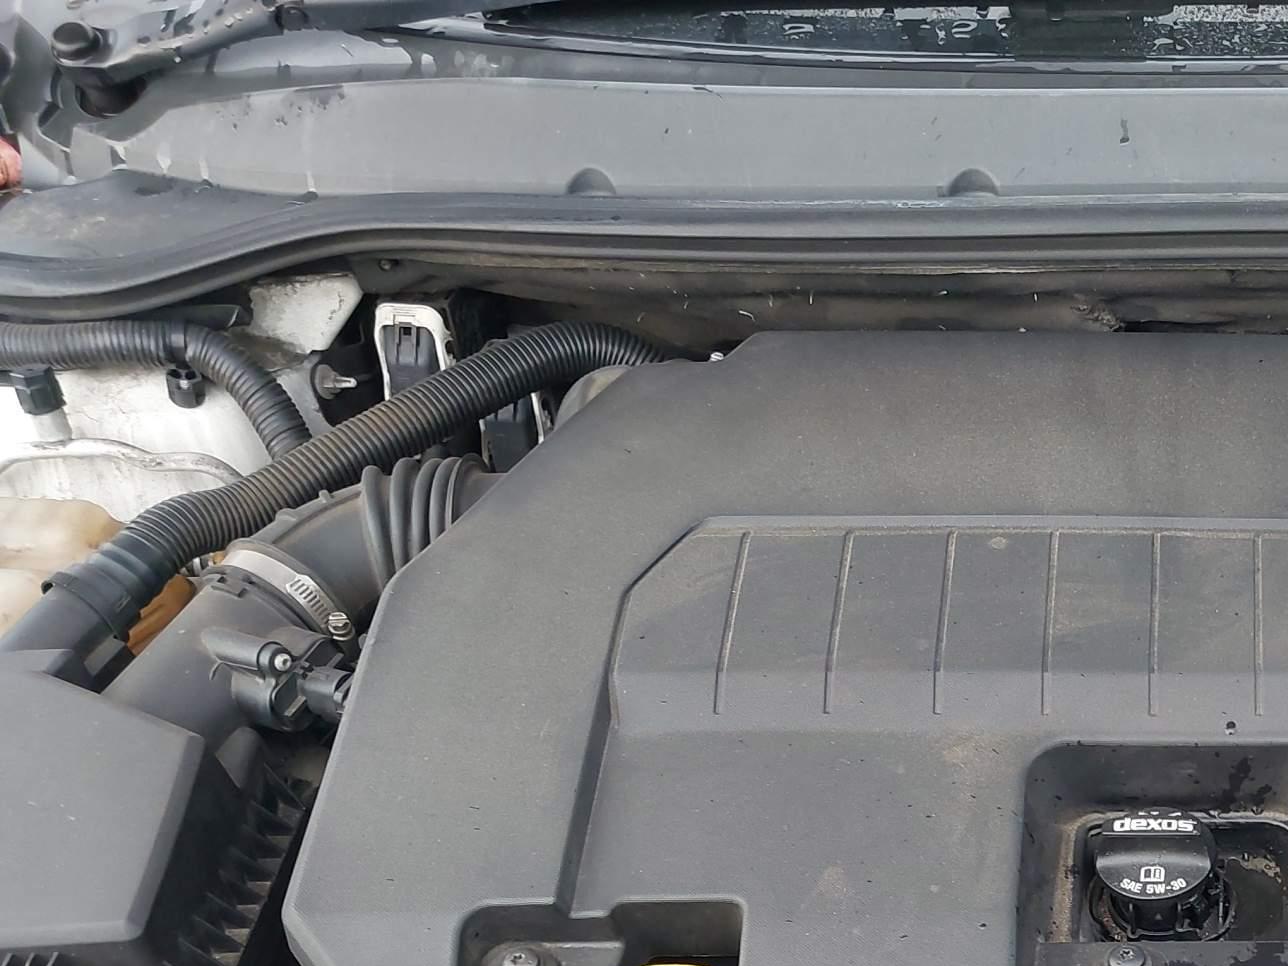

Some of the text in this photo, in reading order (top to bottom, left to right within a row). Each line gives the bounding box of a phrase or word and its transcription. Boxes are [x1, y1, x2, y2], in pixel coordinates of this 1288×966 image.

[1113, 817, 1197, 832] dexos
[1120, 878, 1187, 894] SAE 5W-30
